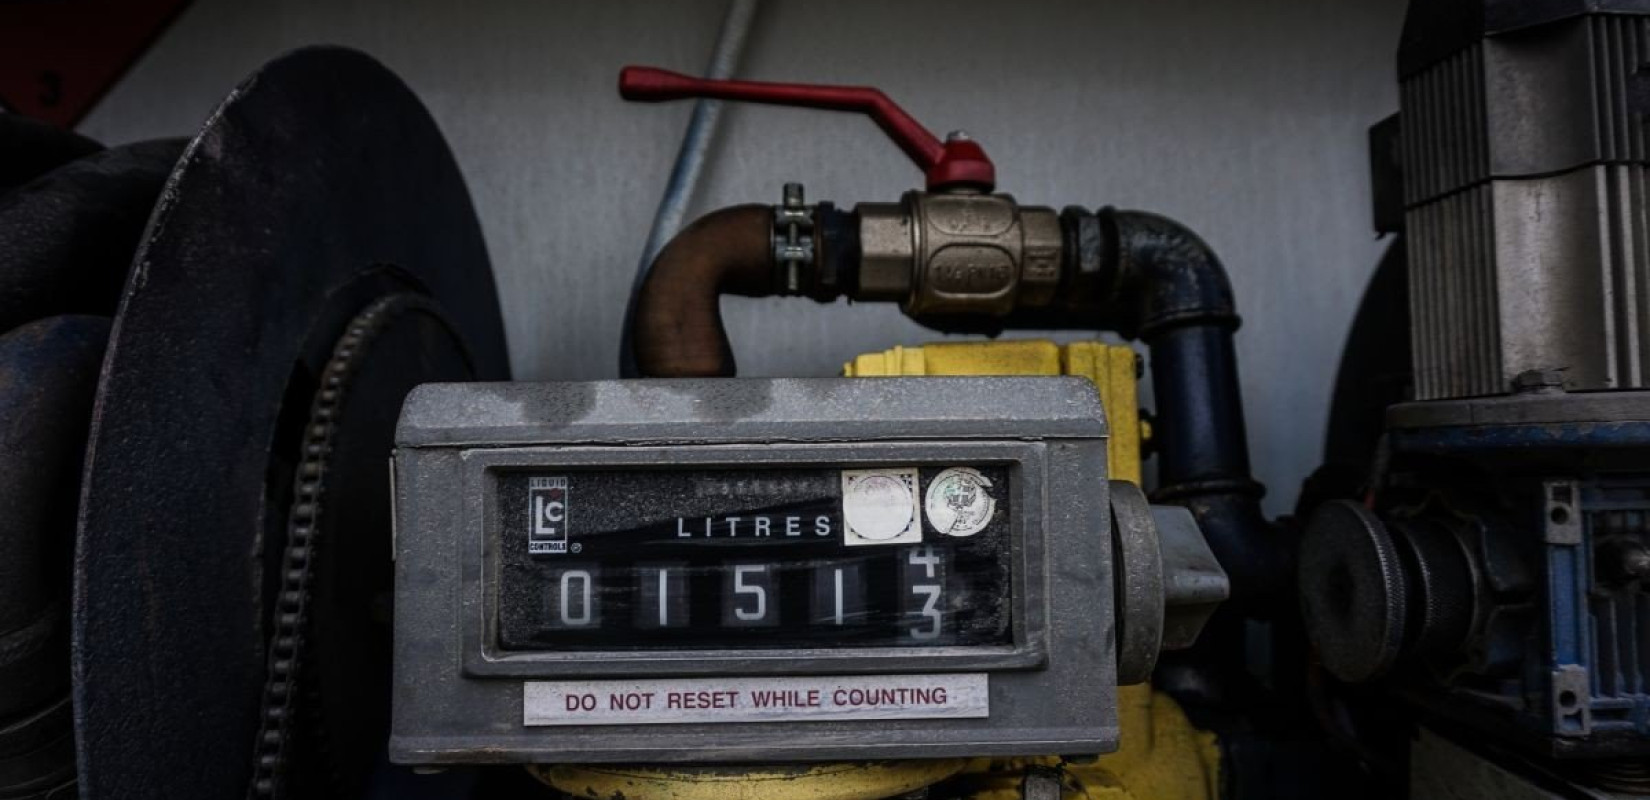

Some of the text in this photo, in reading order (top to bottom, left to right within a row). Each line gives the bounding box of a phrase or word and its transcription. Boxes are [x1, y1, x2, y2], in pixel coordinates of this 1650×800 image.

[39, 70, 60, 107] 3
[530, 478, 567, 489] LIQUID
[677, 515, 831, 537] LITRES
[530, 541, 567, 552] CONTROLS
[565, 687, 949, 712] DO NOT RESET WHILE COUNTING
